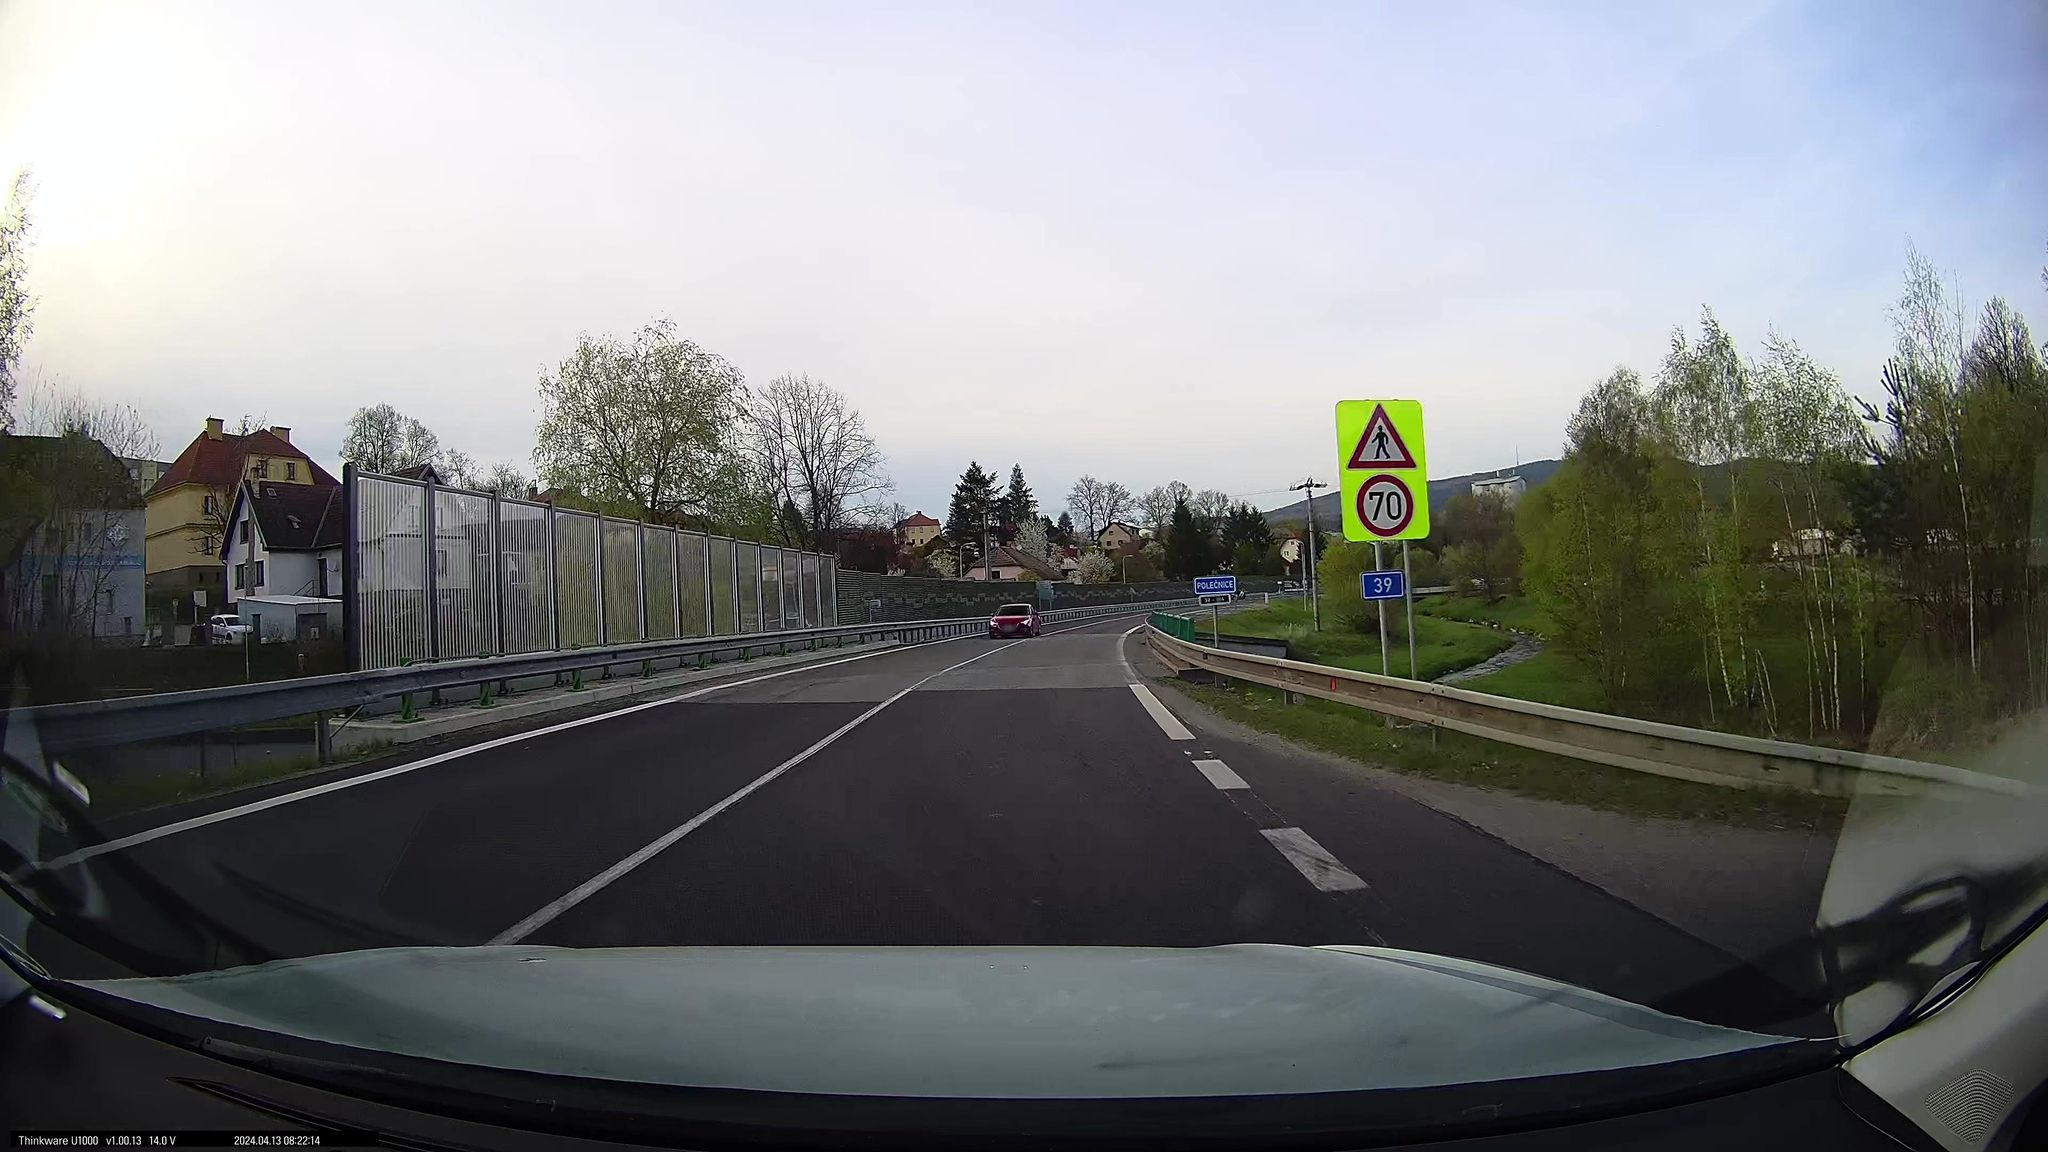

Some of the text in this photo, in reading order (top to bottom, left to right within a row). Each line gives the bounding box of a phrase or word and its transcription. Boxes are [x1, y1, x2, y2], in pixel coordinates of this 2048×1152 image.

[1368, 491, 1402, 521] 70
[1197, 580, 1234, 590] POLEČNICE
[1374, 577, 1392, 593] 39
